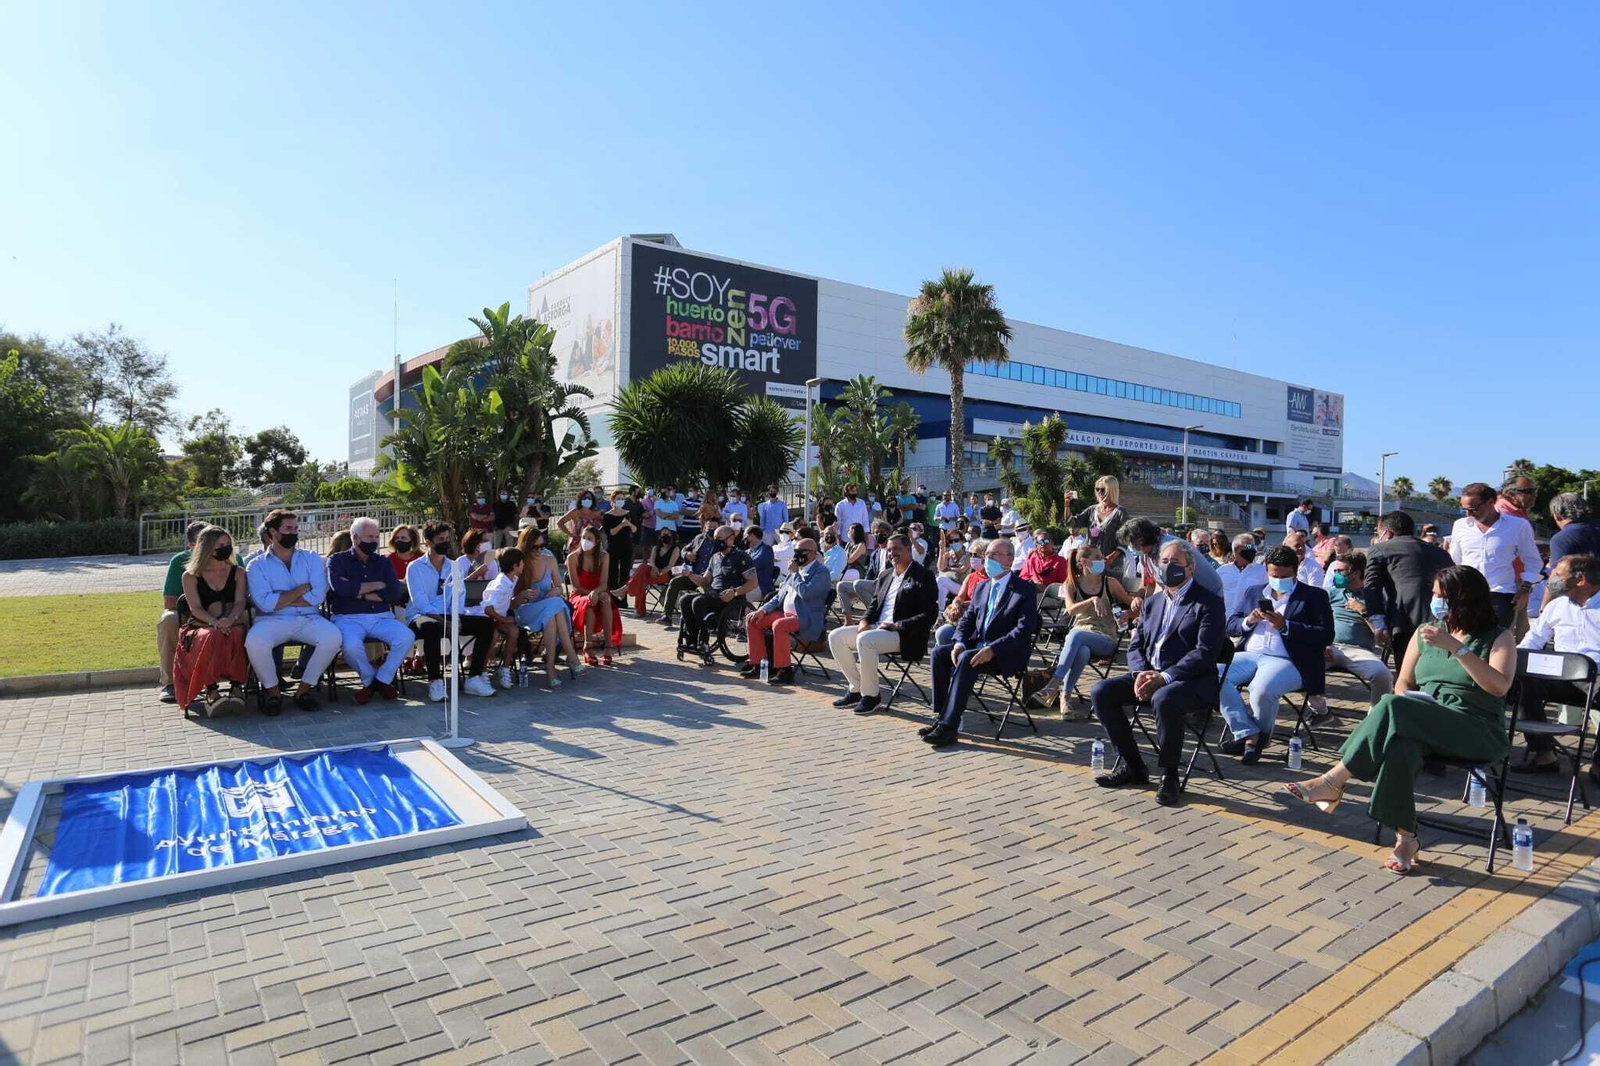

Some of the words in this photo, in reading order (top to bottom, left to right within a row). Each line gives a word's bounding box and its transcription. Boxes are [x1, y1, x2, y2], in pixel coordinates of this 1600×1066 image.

[653, 265, 731, 304] #SOY
[666, 295, 725, 323] huerto
[726, 288, 747, 347] zen
[747, 292, 798, 336] 5G
[665, 315, 725, 343] barrio
[668, 345, 701, 358] PASOS
[700, 343, 781, 374] smart
[1105, 438, 1115, 446] DE
[1119, 439, 1158, 451] DEPORTES
[154, 808, 377, 850] Ayuntamiento
[187, 843, 230, 857] de
